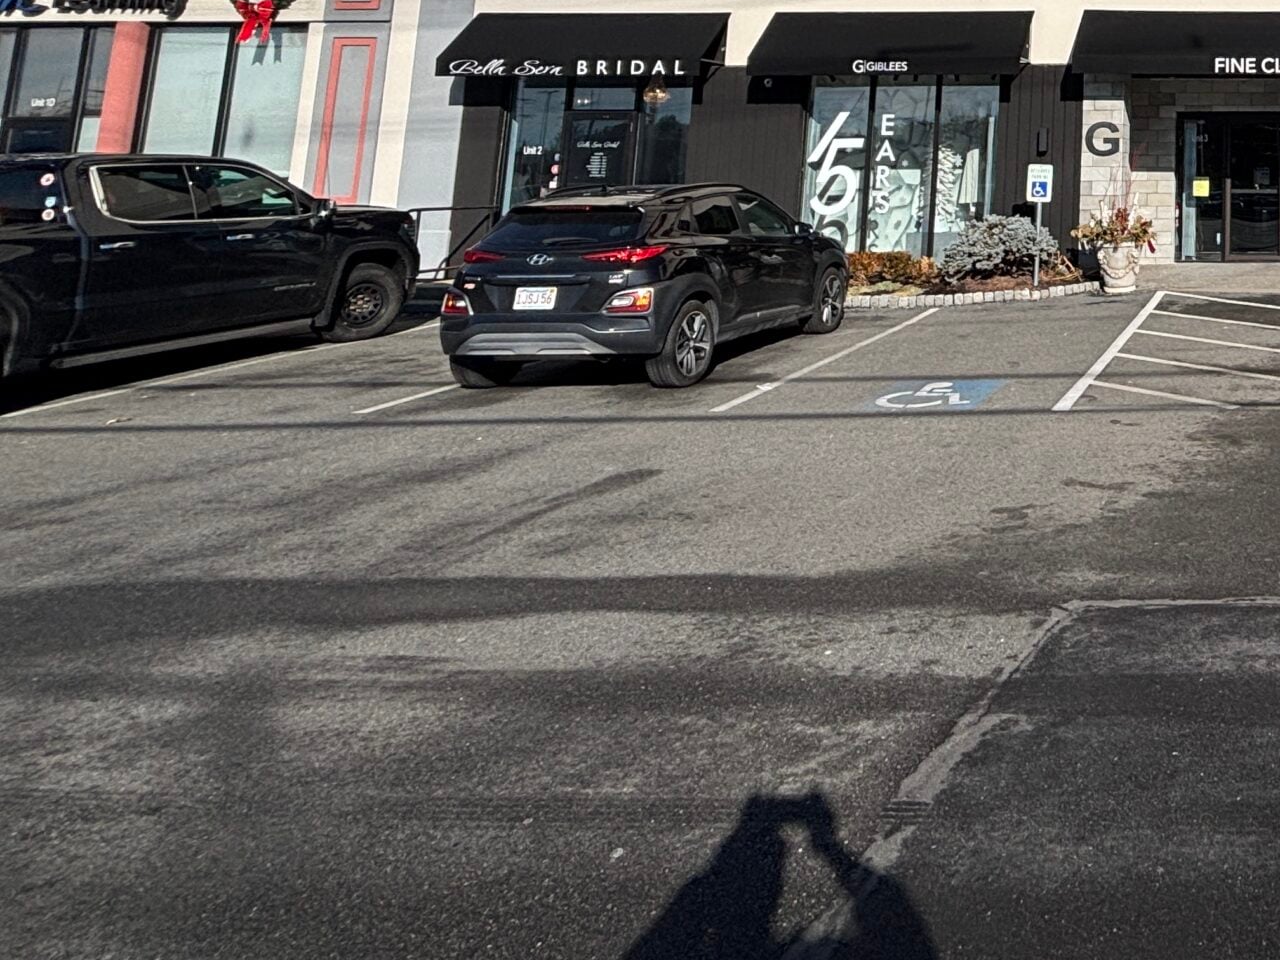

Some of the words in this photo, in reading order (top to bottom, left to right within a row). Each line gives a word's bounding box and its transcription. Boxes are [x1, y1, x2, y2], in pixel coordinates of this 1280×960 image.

[449, 58, 507, 76] Bella
[512, 59, 563, 76] Sera
[576, 59, 685, 76] BRIDAL
[866, 61, 908, 72] GIBLEES
[1214, 57, 1257, 74] FINE
[1085, 121, 1120, 157] G
